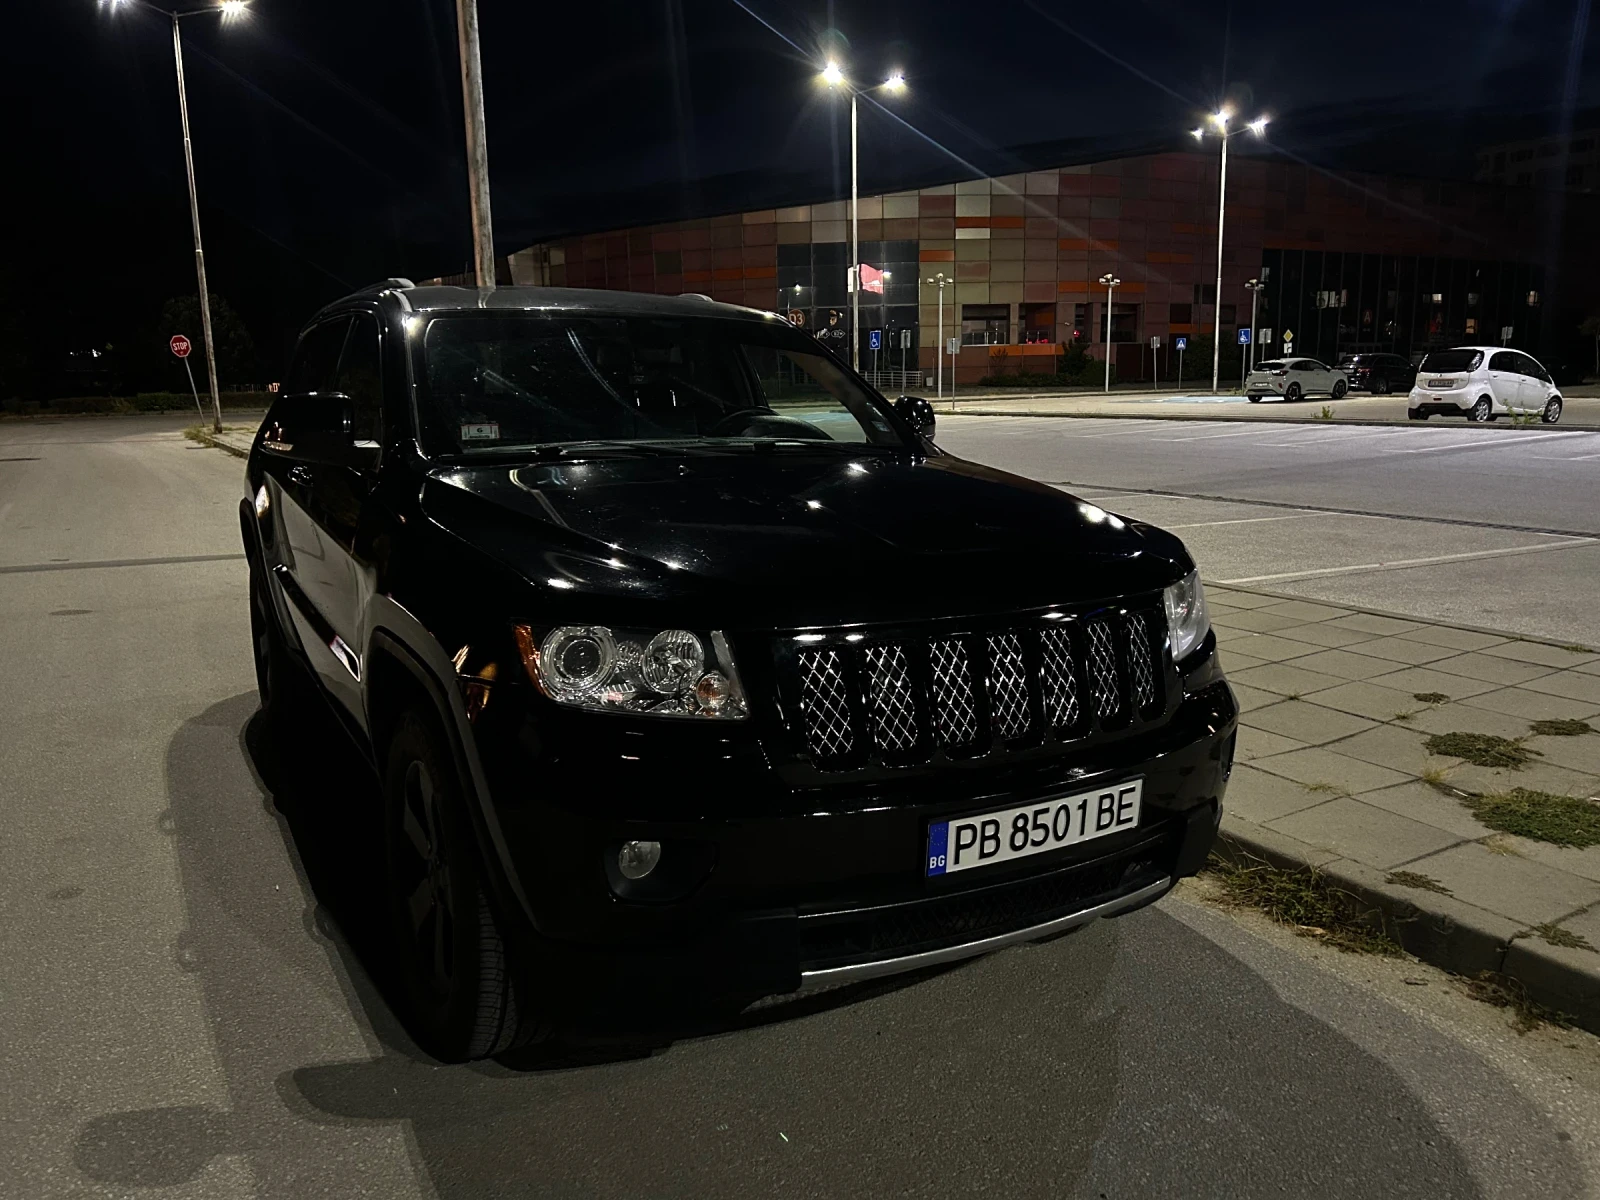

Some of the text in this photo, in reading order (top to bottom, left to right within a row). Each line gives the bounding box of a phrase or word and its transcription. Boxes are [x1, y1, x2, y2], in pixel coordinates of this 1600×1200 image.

[172, 342, 187, 351] STOP
[953, 786, 1136, 865] PB 8501 BE
[929, 856, 946, 869] BG
